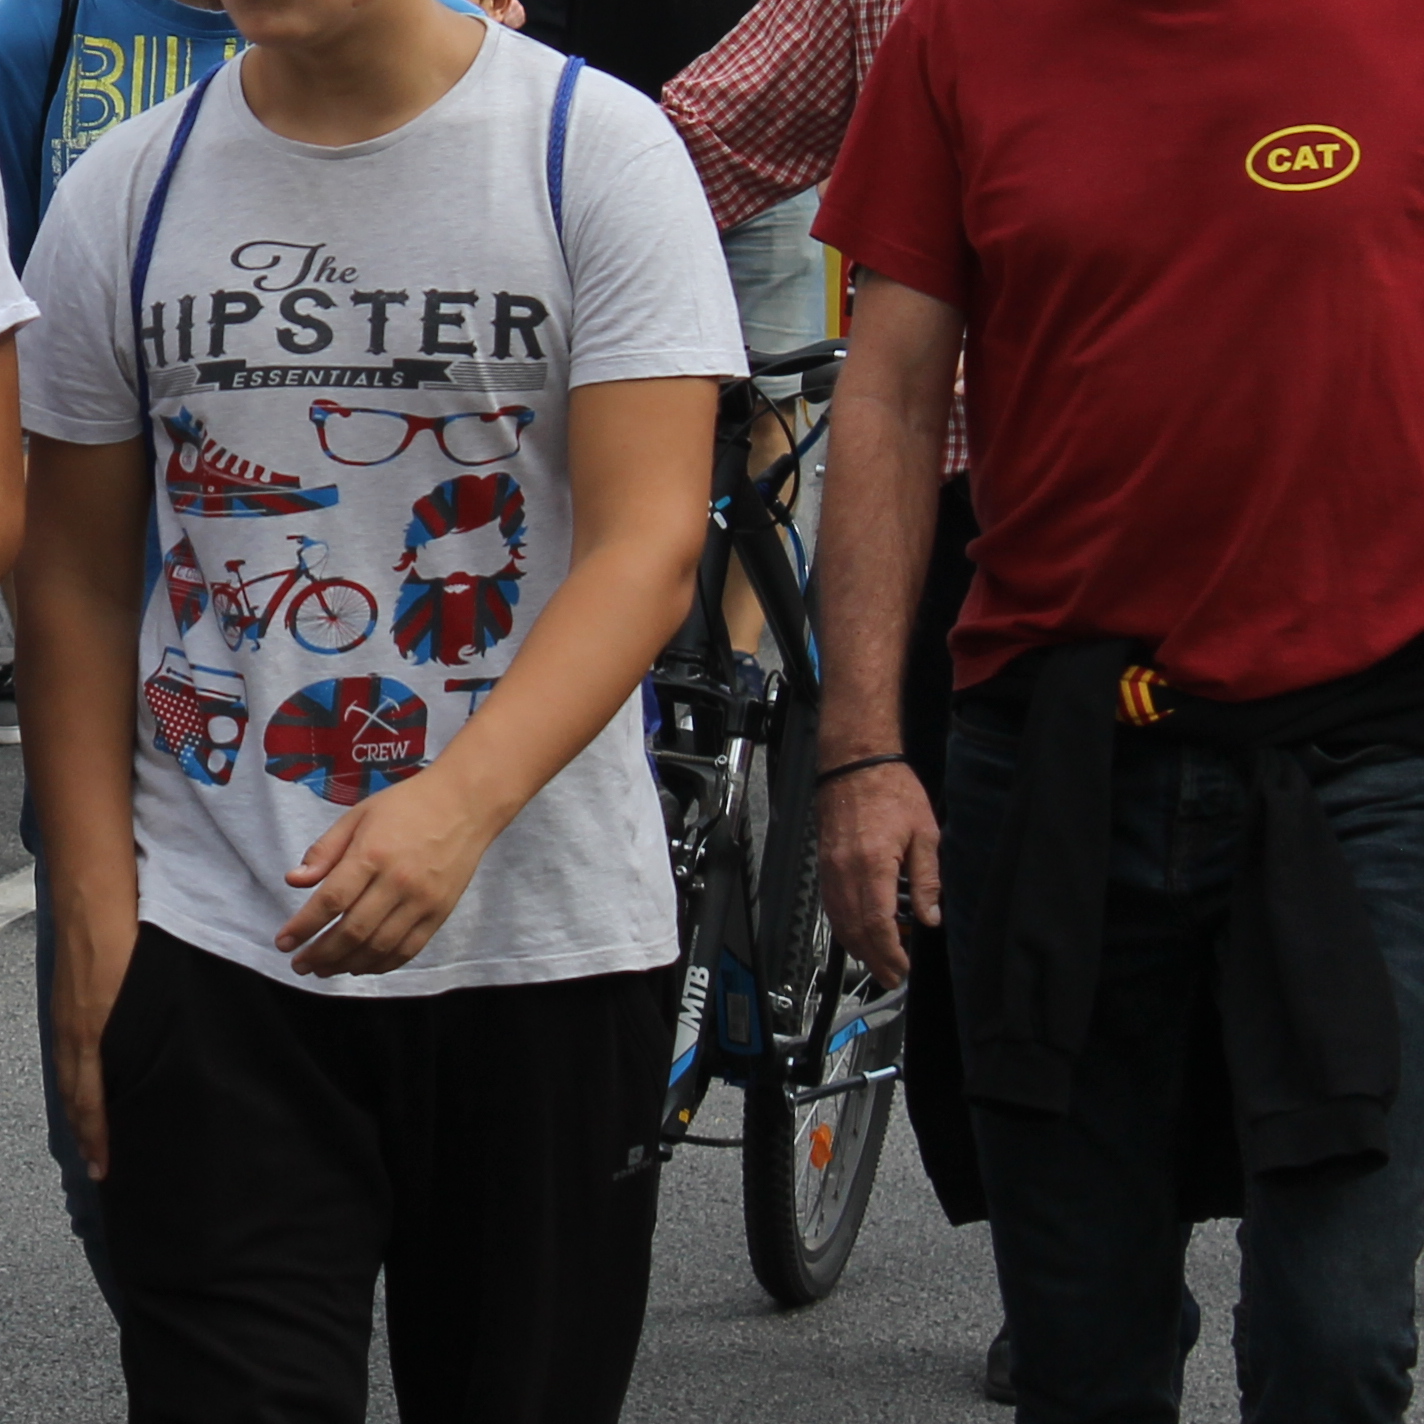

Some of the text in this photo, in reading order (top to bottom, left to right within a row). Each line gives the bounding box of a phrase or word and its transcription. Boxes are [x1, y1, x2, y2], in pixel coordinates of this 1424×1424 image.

[1266, 143, 1341, 173] CAT
[229, 239, 359, 292] The
[140, 287, 550, 368] HIPSTER
[231, 369, 406, 390] ESSENTIALS
[351, 740, 411, 763] CREW
[678, 964, 710, 1027] MTB
